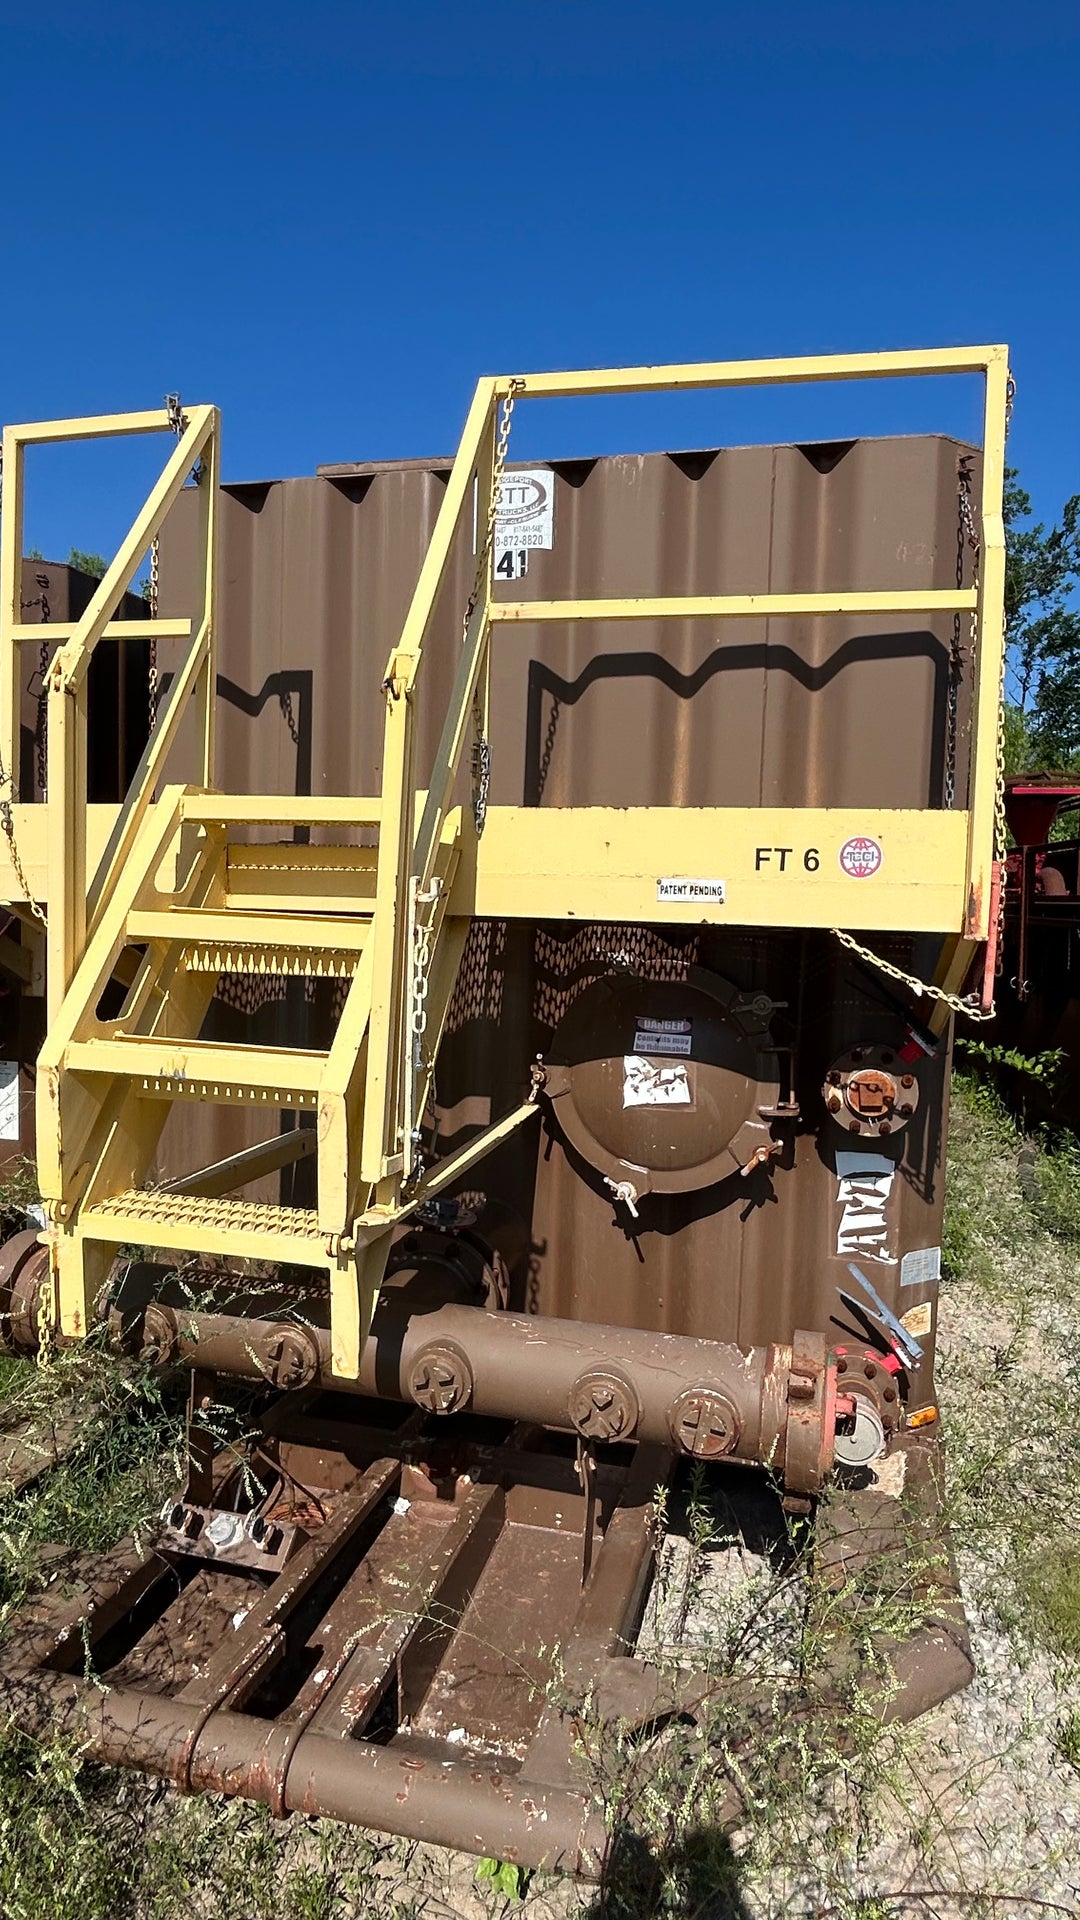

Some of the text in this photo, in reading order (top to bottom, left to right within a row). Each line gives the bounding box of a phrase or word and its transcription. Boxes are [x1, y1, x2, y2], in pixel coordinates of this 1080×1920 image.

[496, 534, 544, 547] 0-872-8820
[755, 847, 820, 872] FT 6
[660, 885, 722, 896] PATENT PENDING
[644, 1019, 684, 1031] DANGER
